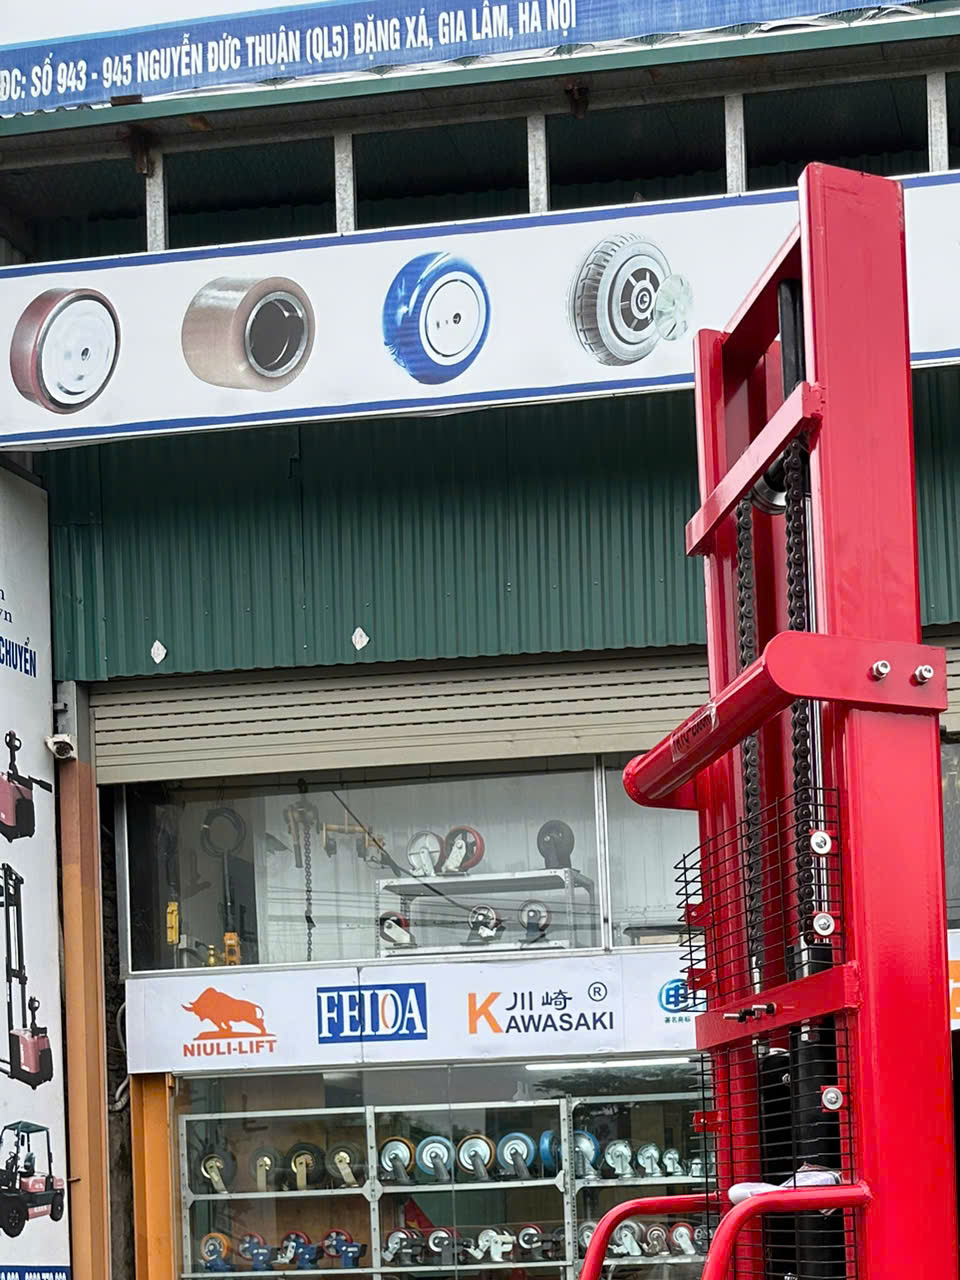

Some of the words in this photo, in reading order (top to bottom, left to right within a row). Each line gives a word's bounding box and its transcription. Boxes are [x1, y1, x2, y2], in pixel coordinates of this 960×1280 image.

[31, 53, 53, 98] SỐ
[57, 60, 87, 94] 943
[103, 54, 132, 89] 945
[137, 33, 203, 83] NGUYỄN
[207, 32, 241, 72] ĐỨC
[246, 25, 300, 71] THUẬN
[306, 24, 348, 64] (QL5)
[354, 13, 401, 60] ĐẶNG
[405, 8, 433, 50] XÁ,
[438, 10, 467, 46] GIA
[472, 0, 513, 40] LÂM,
[318, 988, 426, 1038] FEIDA
[468, 991, 614, 1034] KAWASAKI
[183, 1040, 277, 1057] NIULI-LIFT
